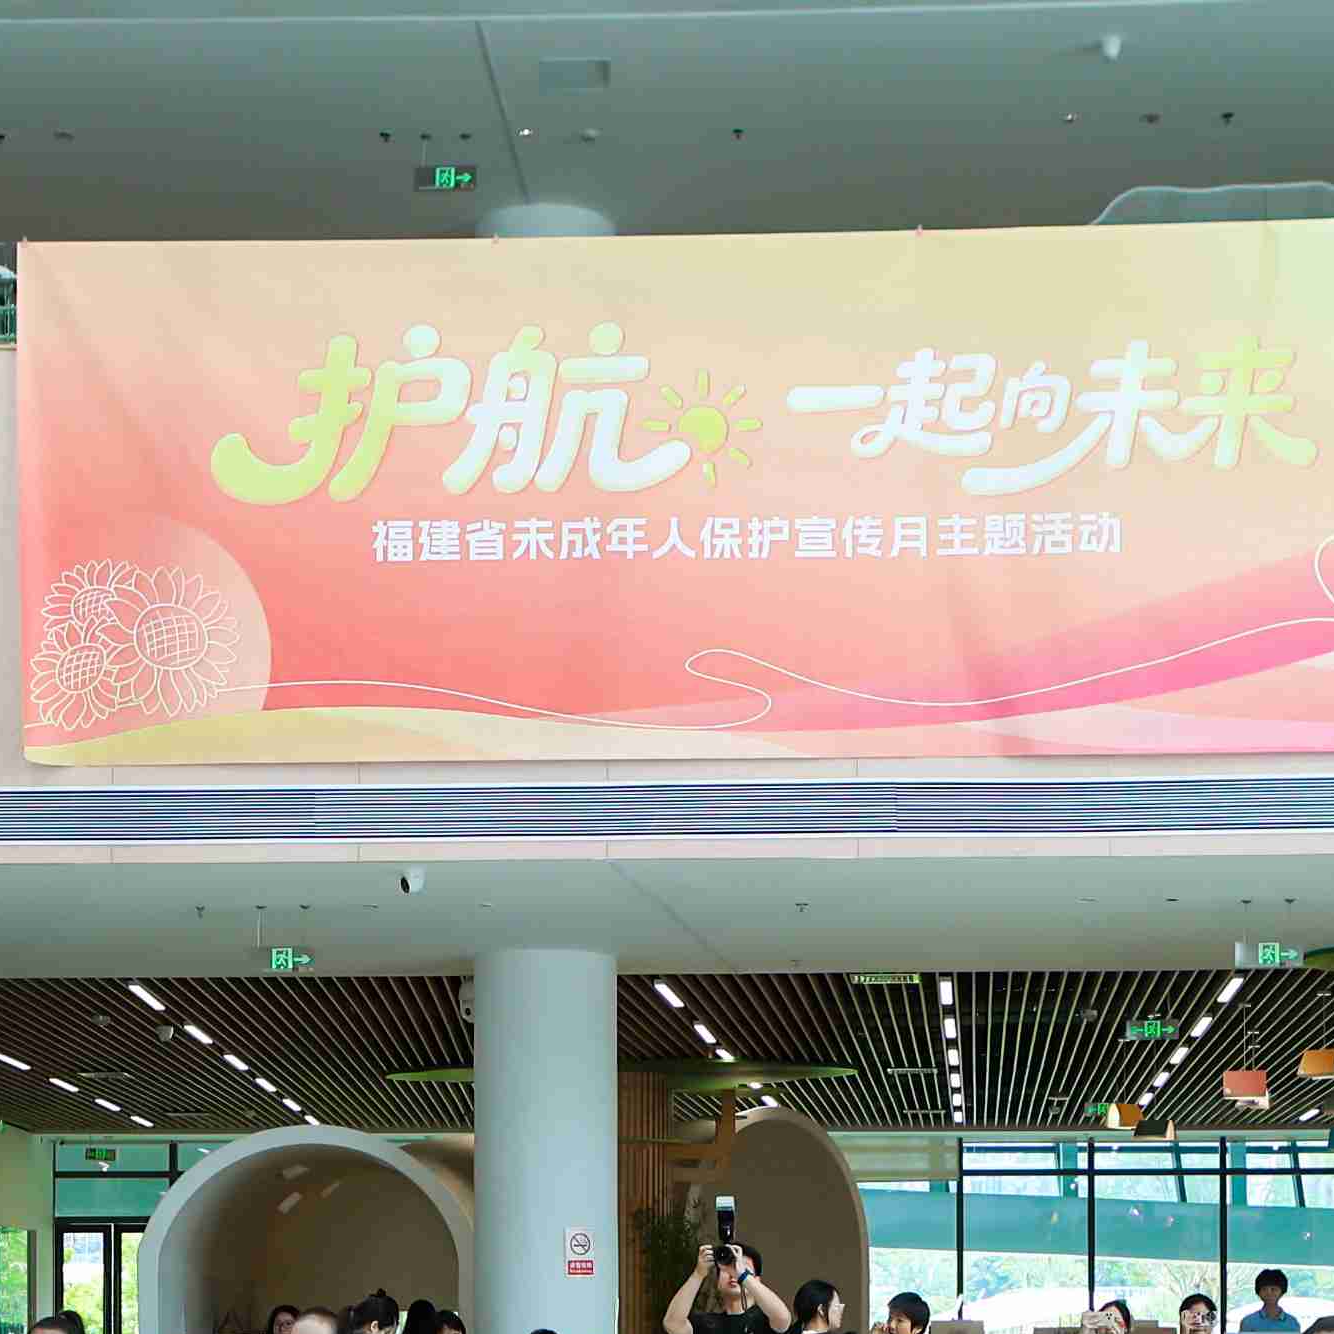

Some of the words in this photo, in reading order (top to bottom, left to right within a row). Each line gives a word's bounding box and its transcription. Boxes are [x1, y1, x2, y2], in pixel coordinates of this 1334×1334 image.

[211, 321, 691, 506] 护航
[785, 335, 1319, 497] 一起向未来
[371, 511, 1123, 563] 福建省未成年人保护宣传月主题活动
